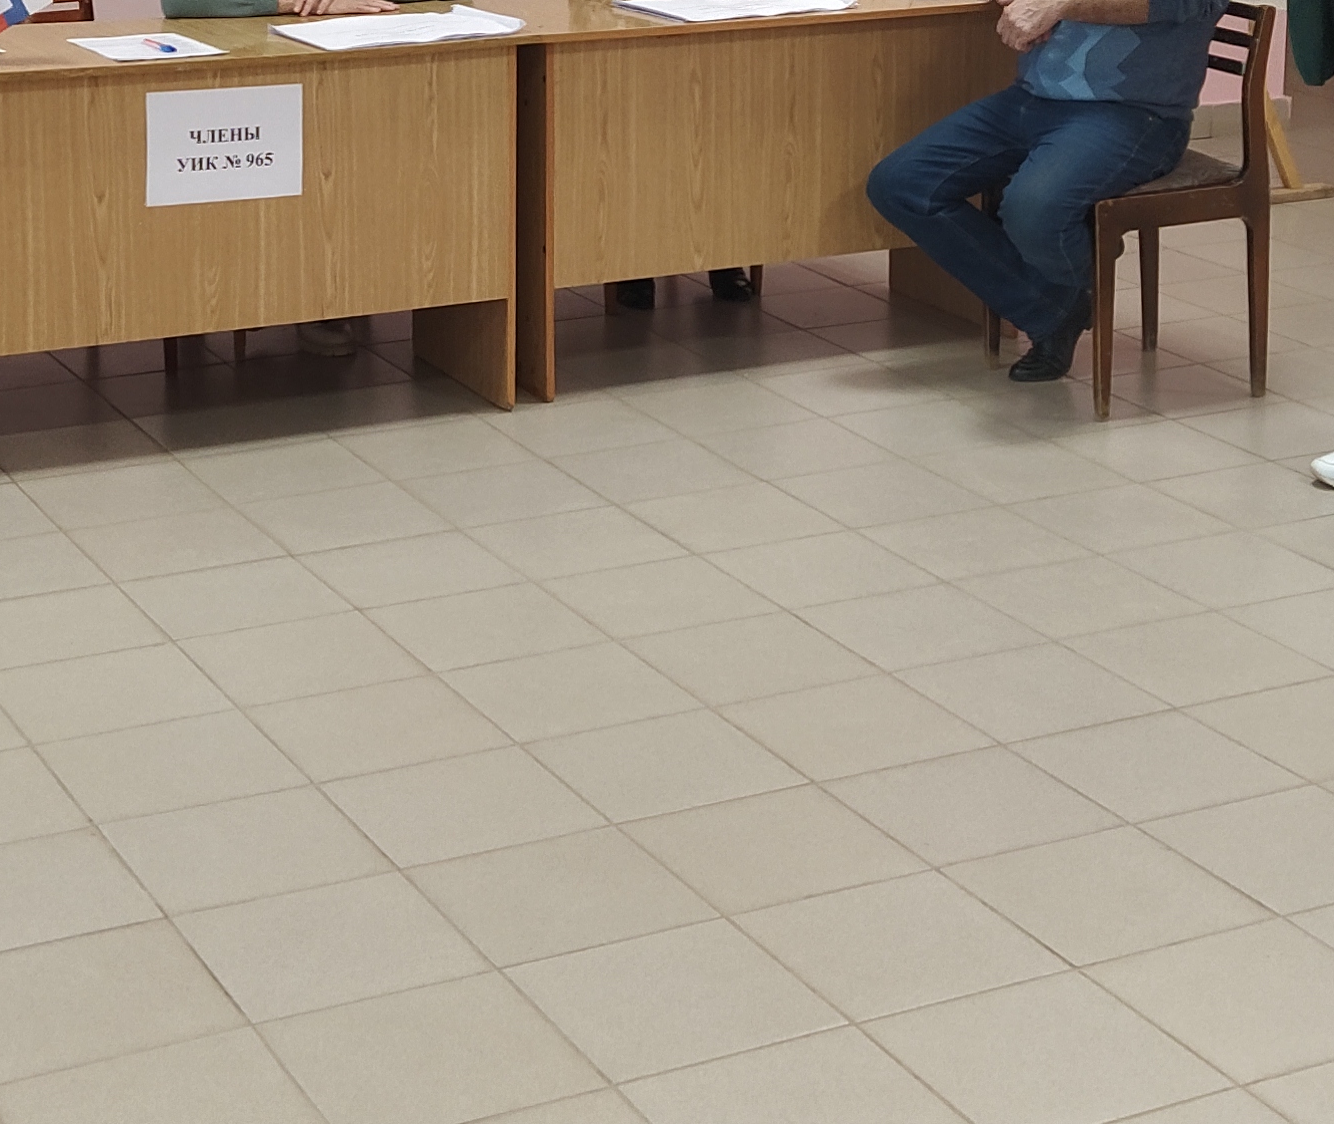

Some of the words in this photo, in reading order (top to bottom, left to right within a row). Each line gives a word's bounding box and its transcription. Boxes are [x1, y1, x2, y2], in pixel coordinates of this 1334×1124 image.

[189, 126, 261, 144] ЧЛЕНЫ
[176, 156, 219, 173] УИК
[221, 154, 242, 169] №
[246, 152, 275, 168] 965
